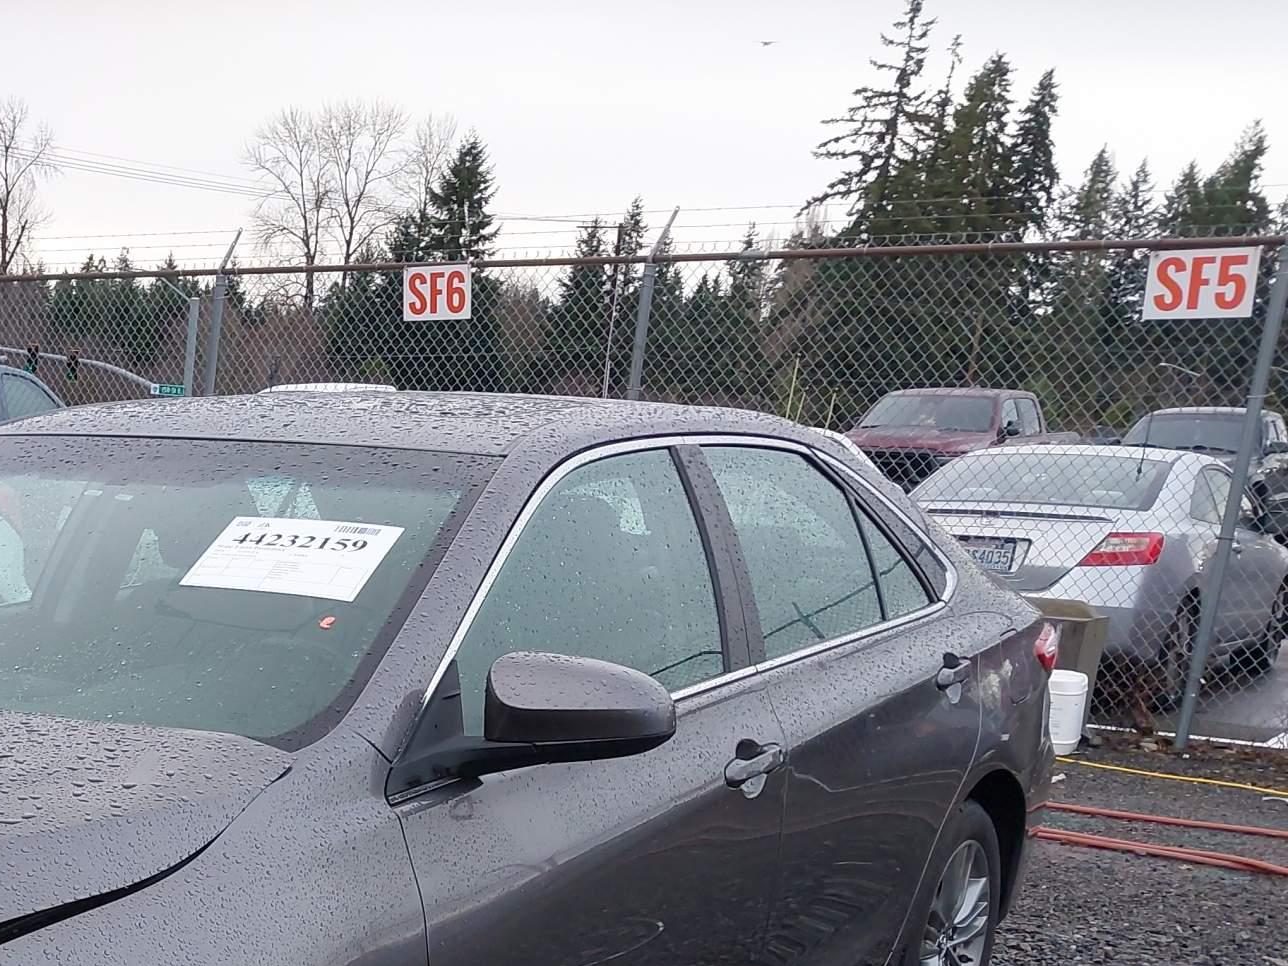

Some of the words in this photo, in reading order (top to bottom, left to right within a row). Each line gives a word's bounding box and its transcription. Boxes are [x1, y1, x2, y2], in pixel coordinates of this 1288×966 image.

[408, 270, 466, 316] SF6
[1153, 254, 1249, 312] SF5
[231, 531, 369, 553] 44232159
[966, 549, 1011, 566] S4035
